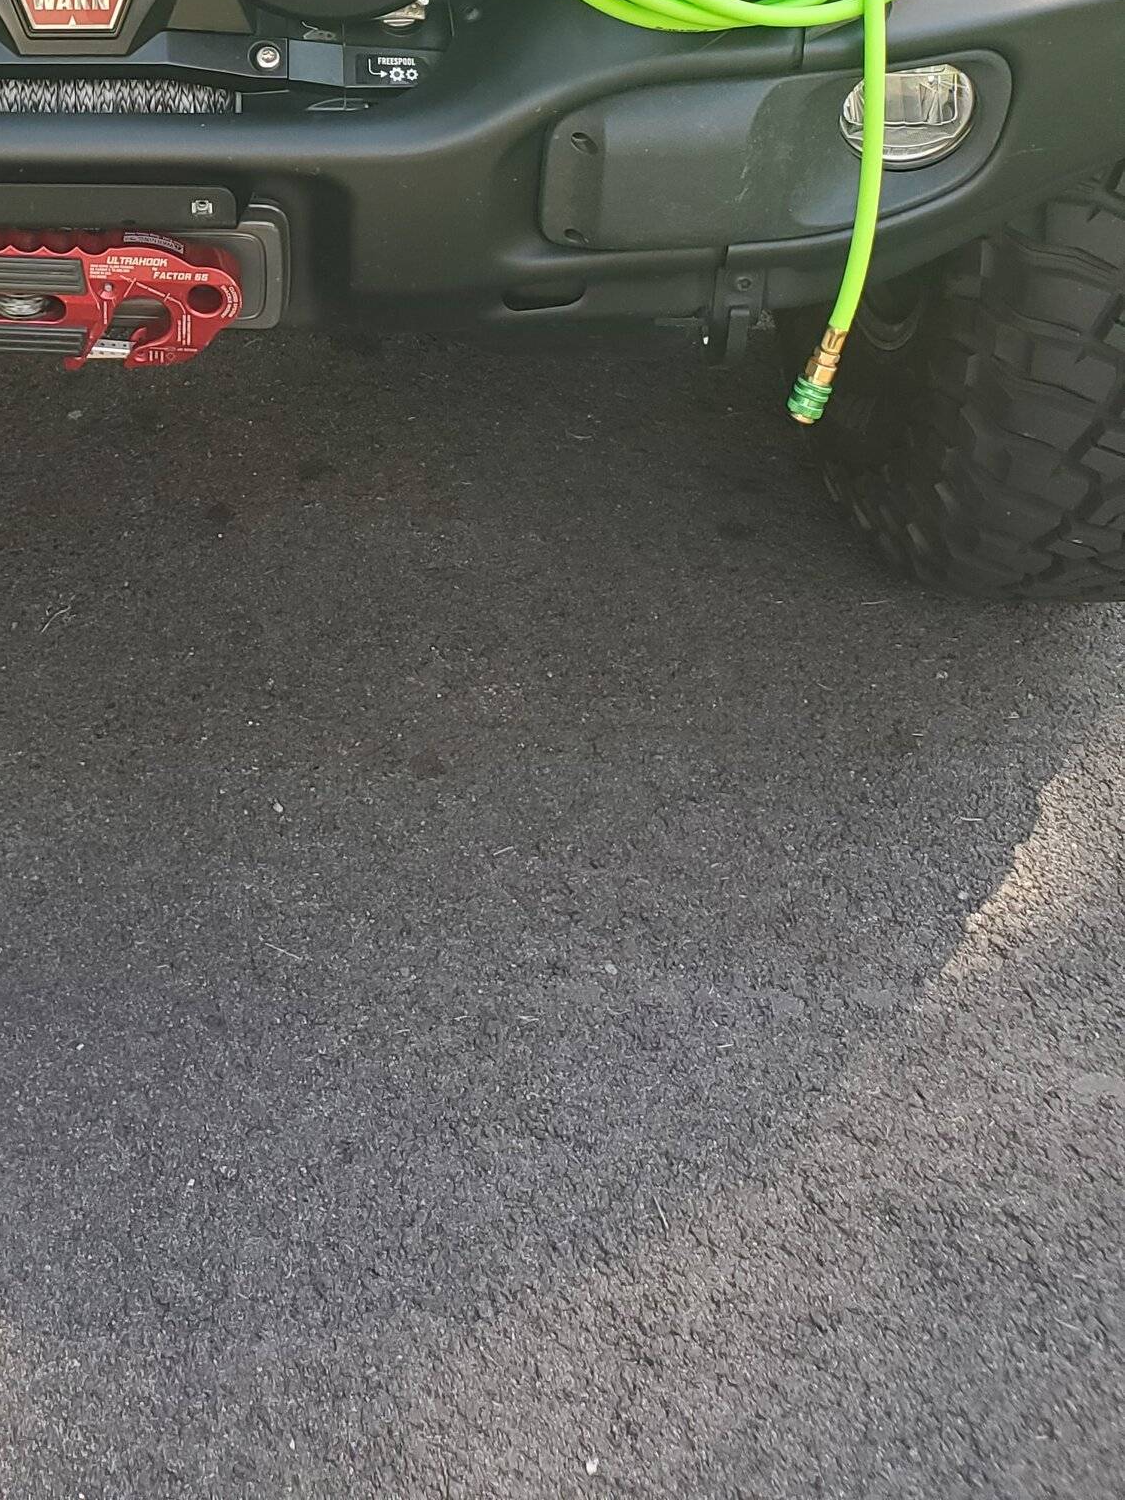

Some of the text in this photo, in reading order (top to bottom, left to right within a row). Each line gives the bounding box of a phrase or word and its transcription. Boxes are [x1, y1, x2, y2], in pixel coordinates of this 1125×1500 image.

[377, 56, 416, 66] FREESPOOL
[106, 256, 168, 267] ULTRAHOOK
[152, 271, 192, 281] FACTOR
